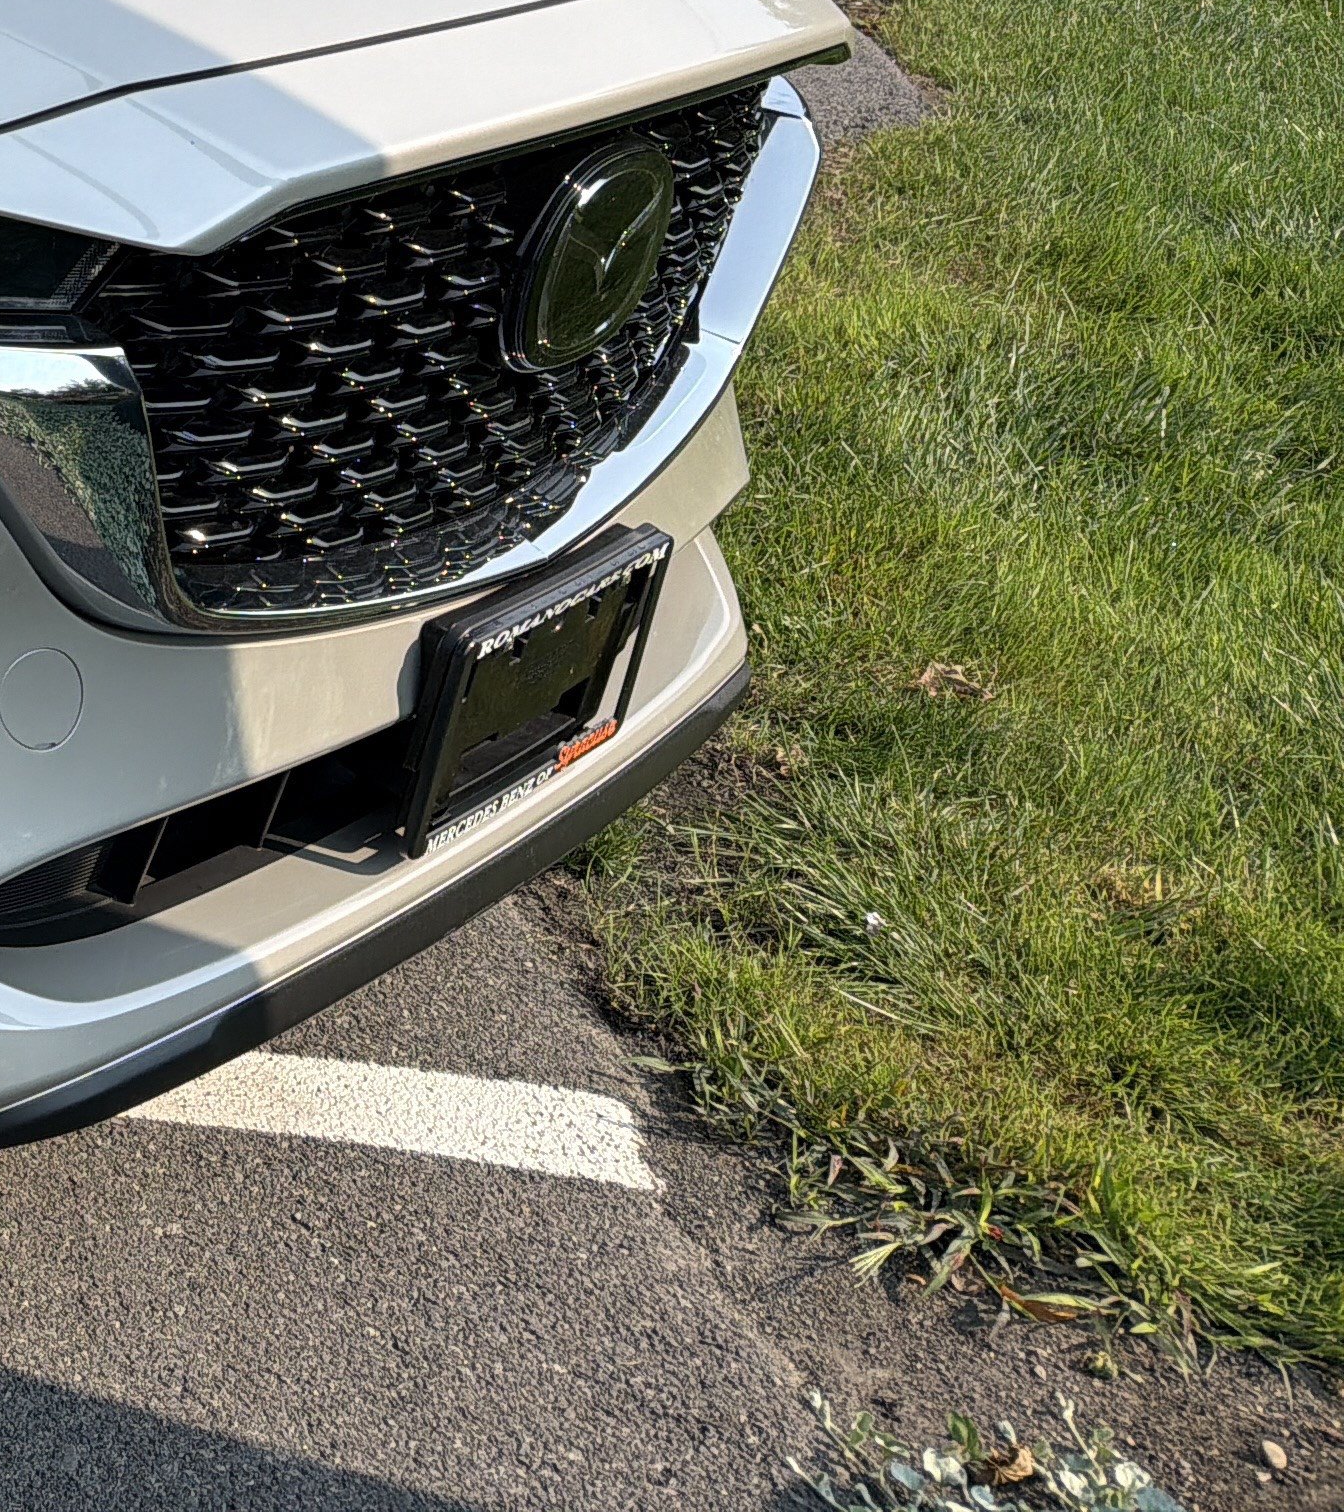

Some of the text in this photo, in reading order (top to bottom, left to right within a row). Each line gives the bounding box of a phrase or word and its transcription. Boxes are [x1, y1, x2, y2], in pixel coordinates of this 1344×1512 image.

[424, 799, 499, 856] MERCEDES
[498, 777, 537, 814] BENZ
[536, 766, 554, 786] OF
